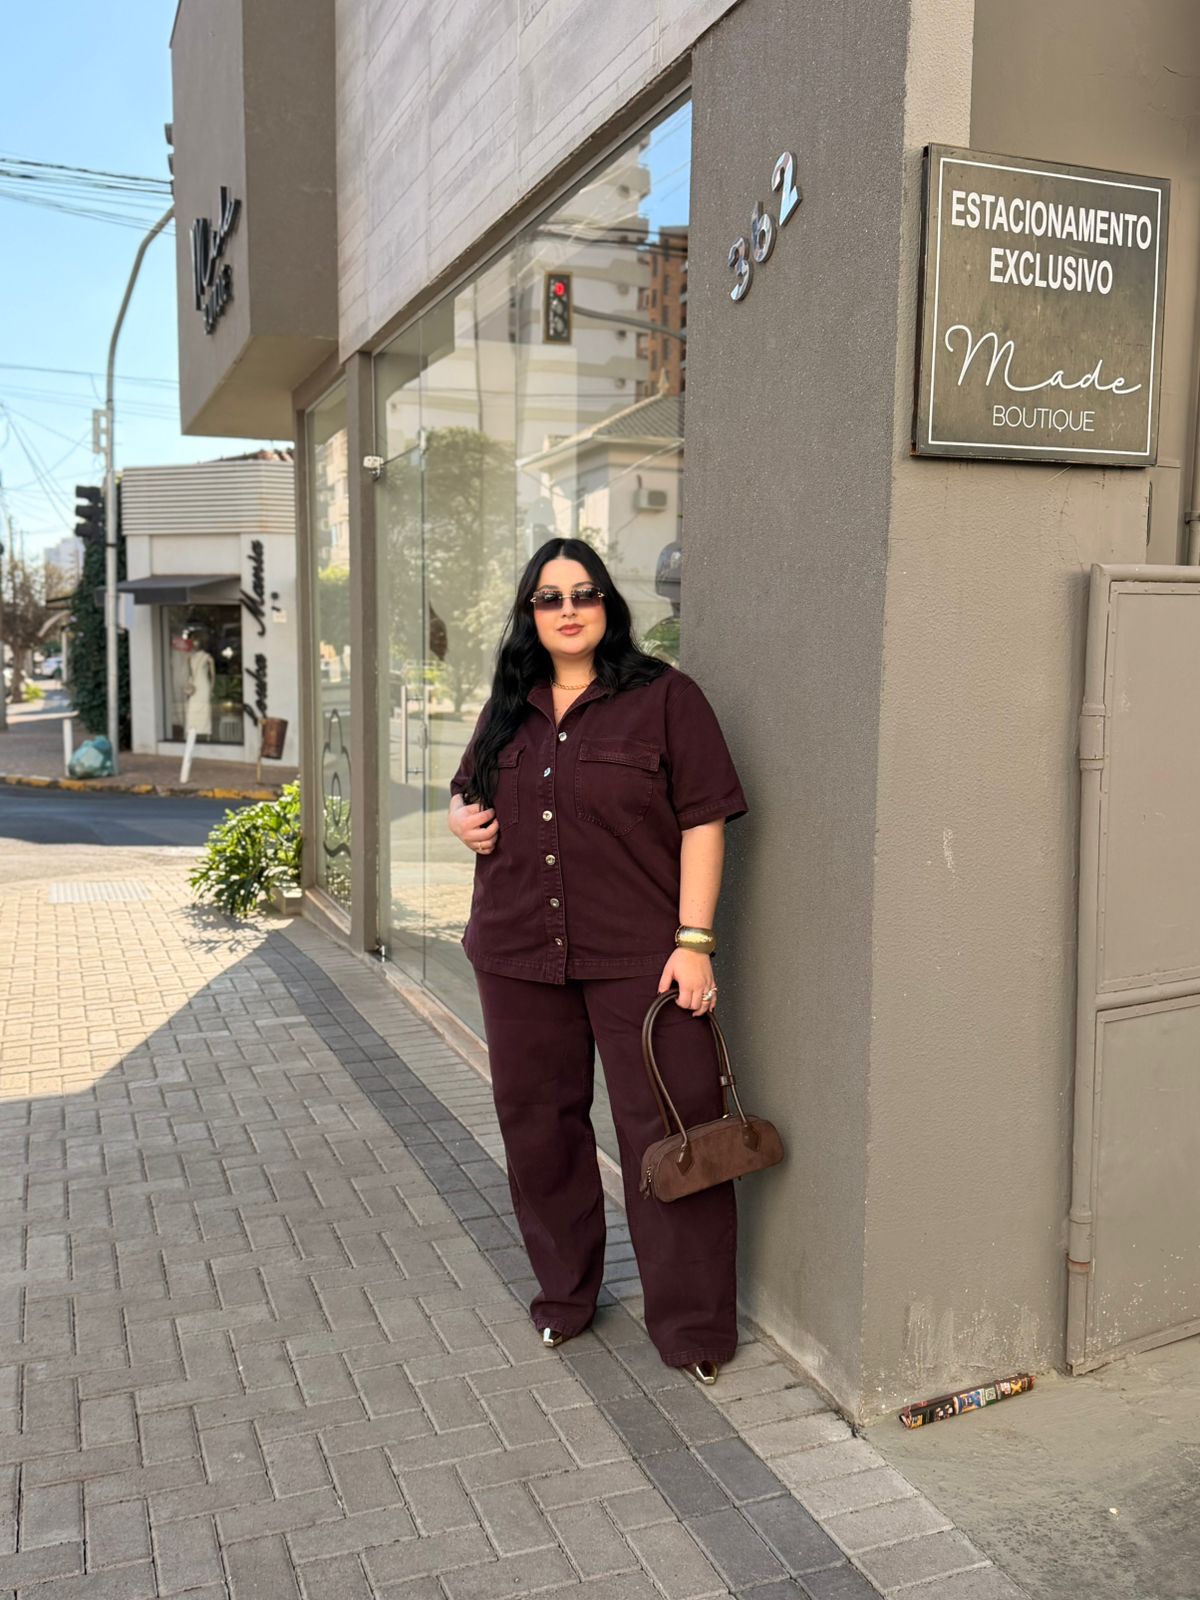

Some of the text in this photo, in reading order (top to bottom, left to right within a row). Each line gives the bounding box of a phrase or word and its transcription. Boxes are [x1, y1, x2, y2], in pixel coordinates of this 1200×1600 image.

[728, 151, 800, 301] 362
[951, 189, 1152, 250] ESTACIONAMENTO
[990, 247, 1113, 295] EXCLUSIVO
[944, 324, 1142, 395] Made
[992, 405, 1096, 433] BOUTIQUE
